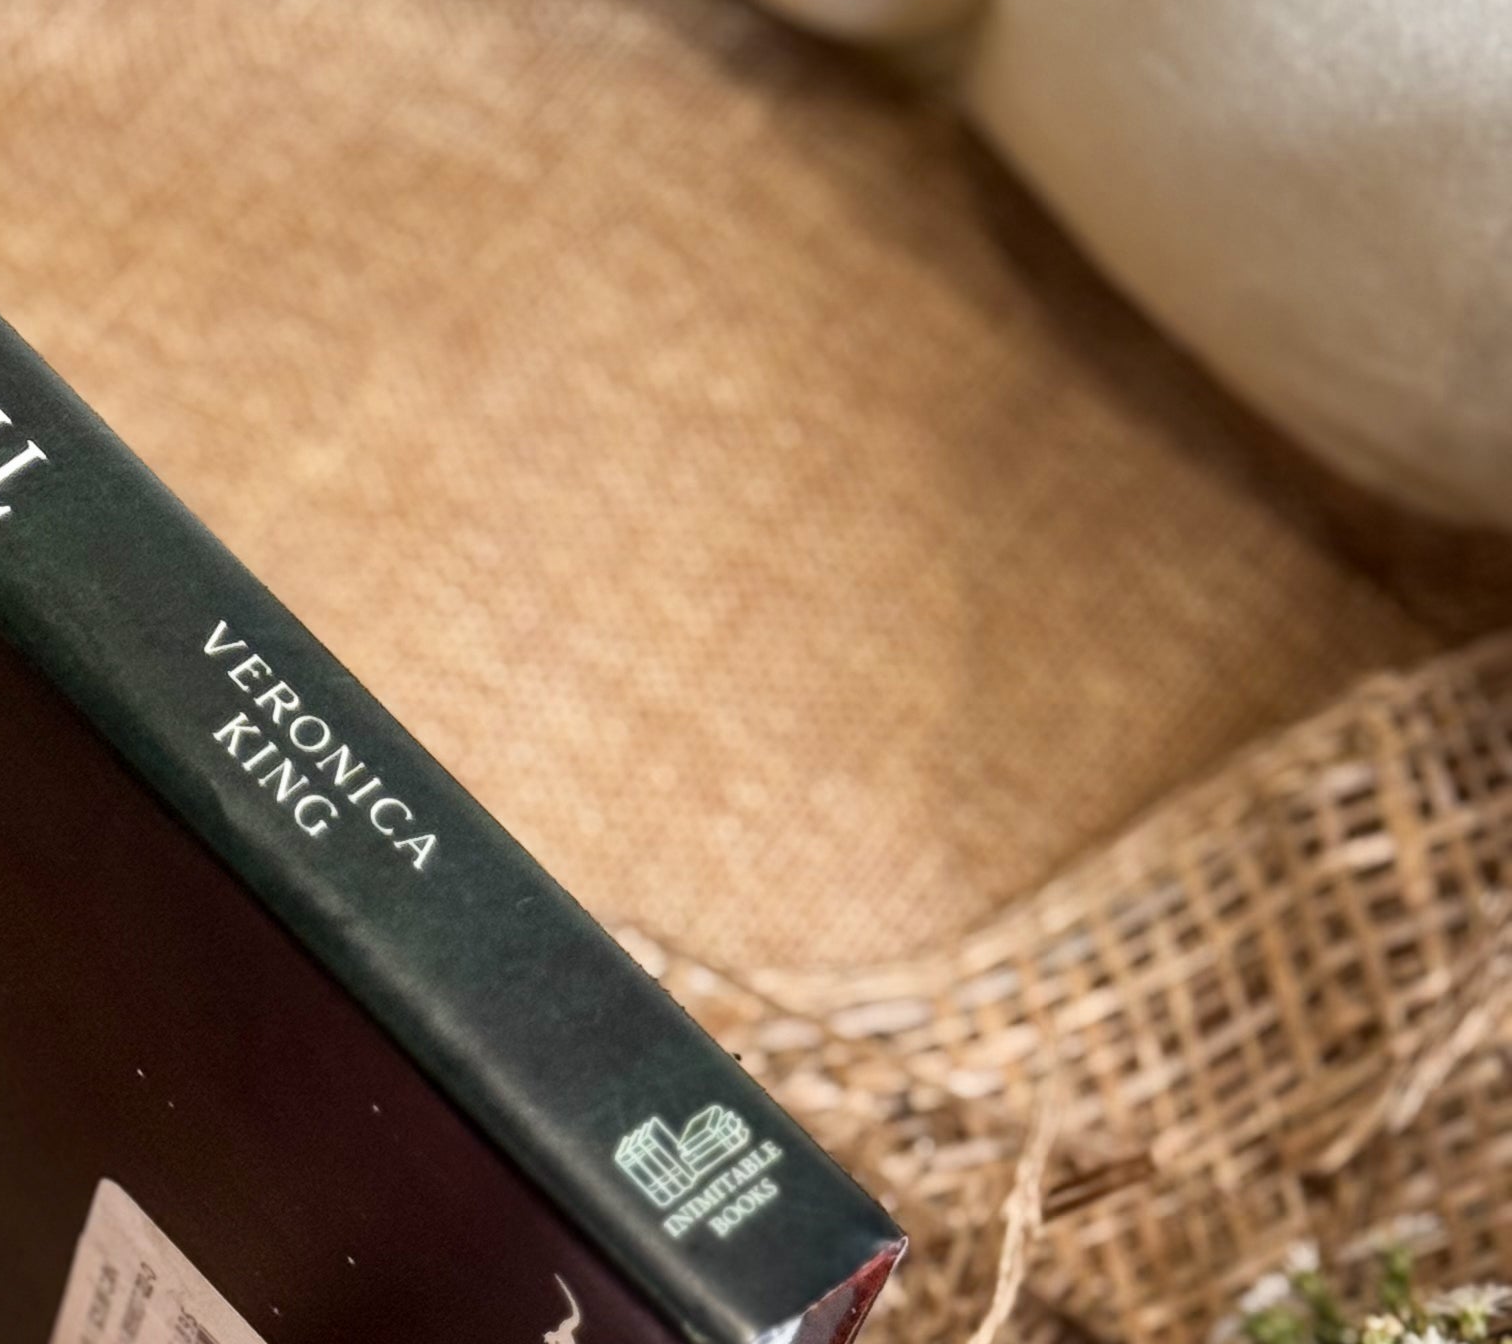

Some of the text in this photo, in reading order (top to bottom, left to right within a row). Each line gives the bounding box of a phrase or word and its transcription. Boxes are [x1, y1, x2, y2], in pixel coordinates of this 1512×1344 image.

[203, 619, 437, 871] VERONICA
[212, 711, 338, 839] KING
[662, 1139, 783, 1239] INIMITABLE
[707, 1176, 779, 1239] BOOKS
